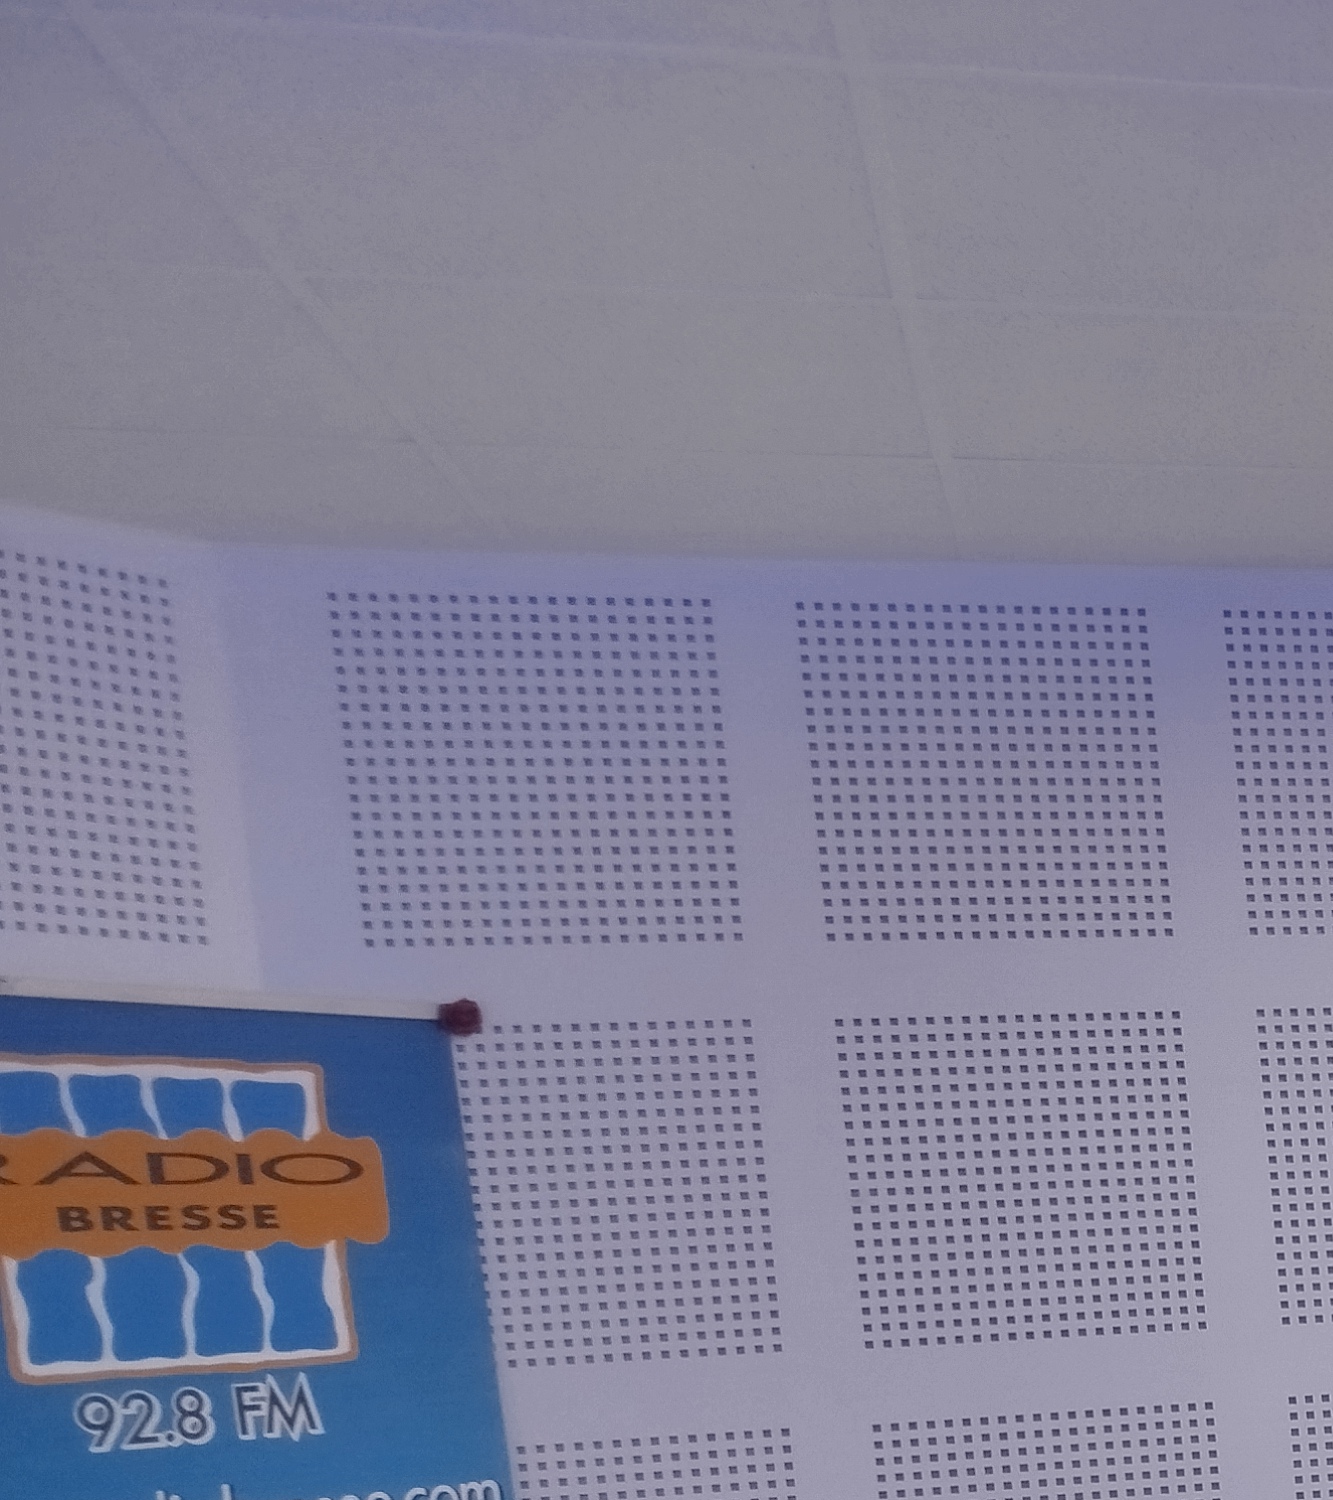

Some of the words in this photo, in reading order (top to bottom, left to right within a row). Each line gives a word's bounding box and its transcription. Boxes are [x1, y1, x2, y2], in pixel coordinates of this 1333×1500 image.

[56, 1203, 281, 1232] BRESSE
[75, 1388, 216, 1452] 92.8
[231, 1374, 325, 1438] FM
